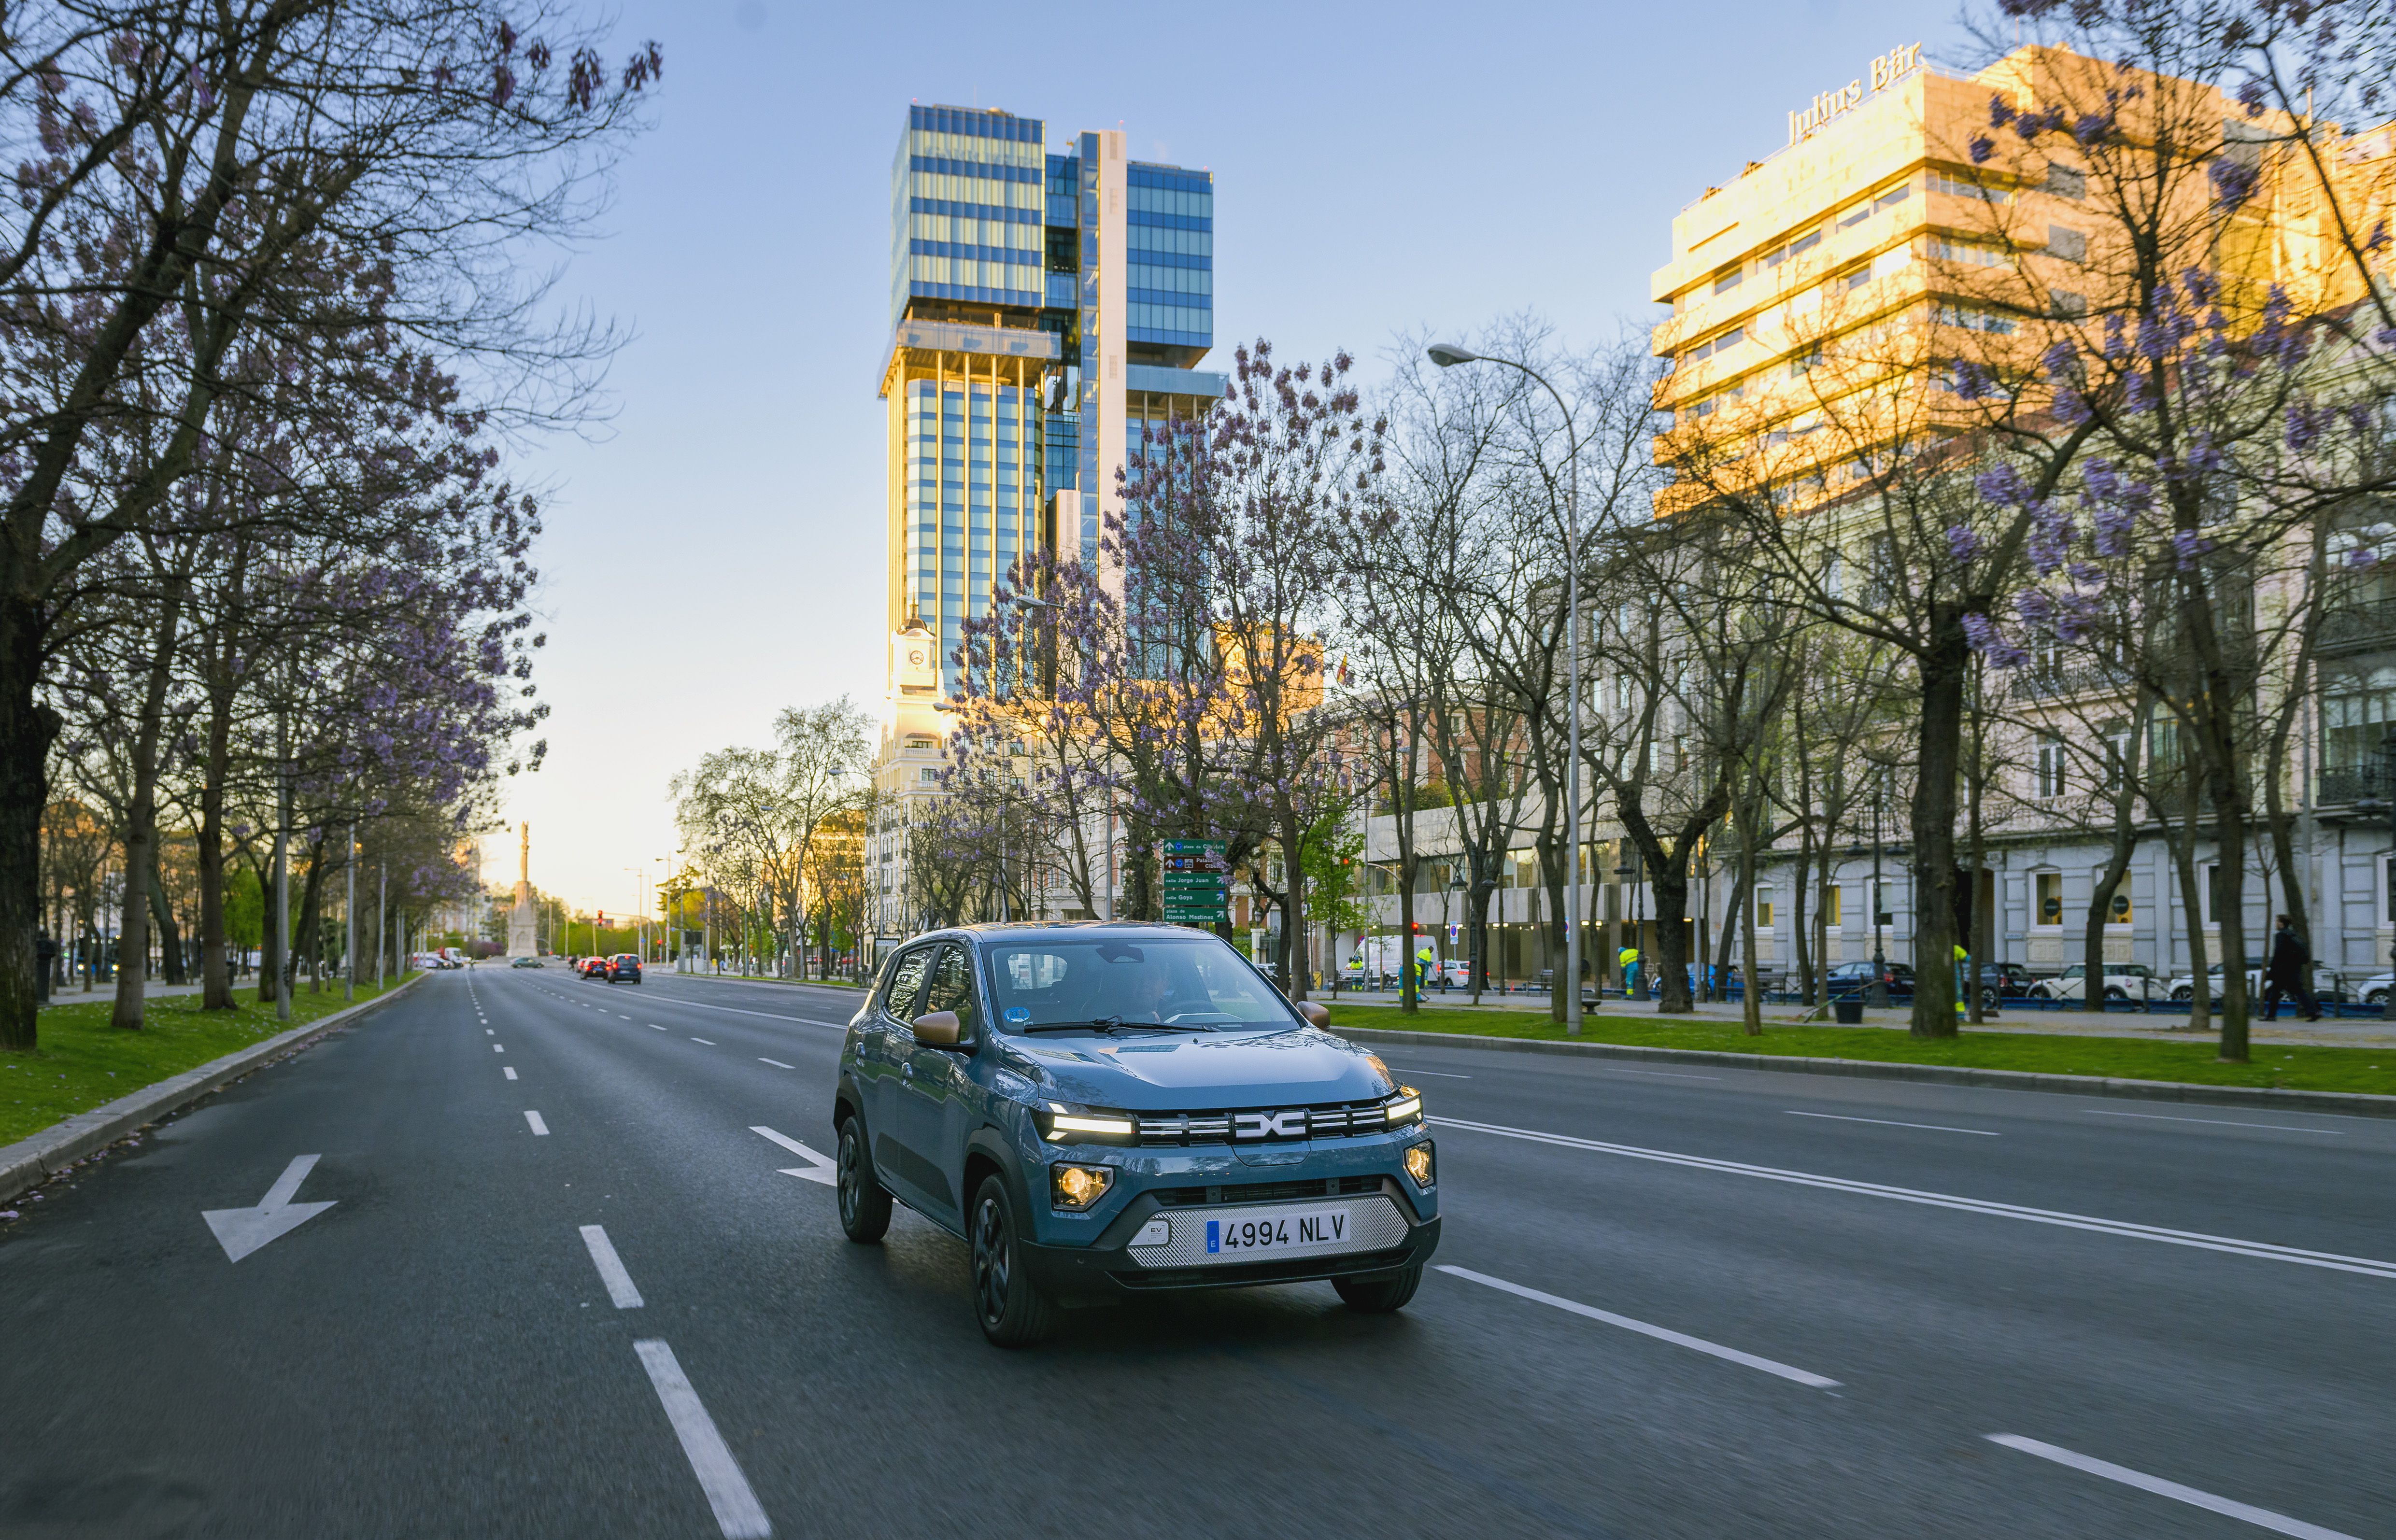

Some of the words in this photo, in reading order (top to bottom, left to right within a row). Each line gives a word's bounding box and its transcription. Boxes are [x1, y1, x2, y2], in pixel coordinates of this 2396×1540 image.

[1788, 79, 1862, 146] Julius
[1870, 41, 1922, 92] Bär
[1225, 1220, 1289, 1248] 4994
[1300, 1215, 1344, 1243] NLV
